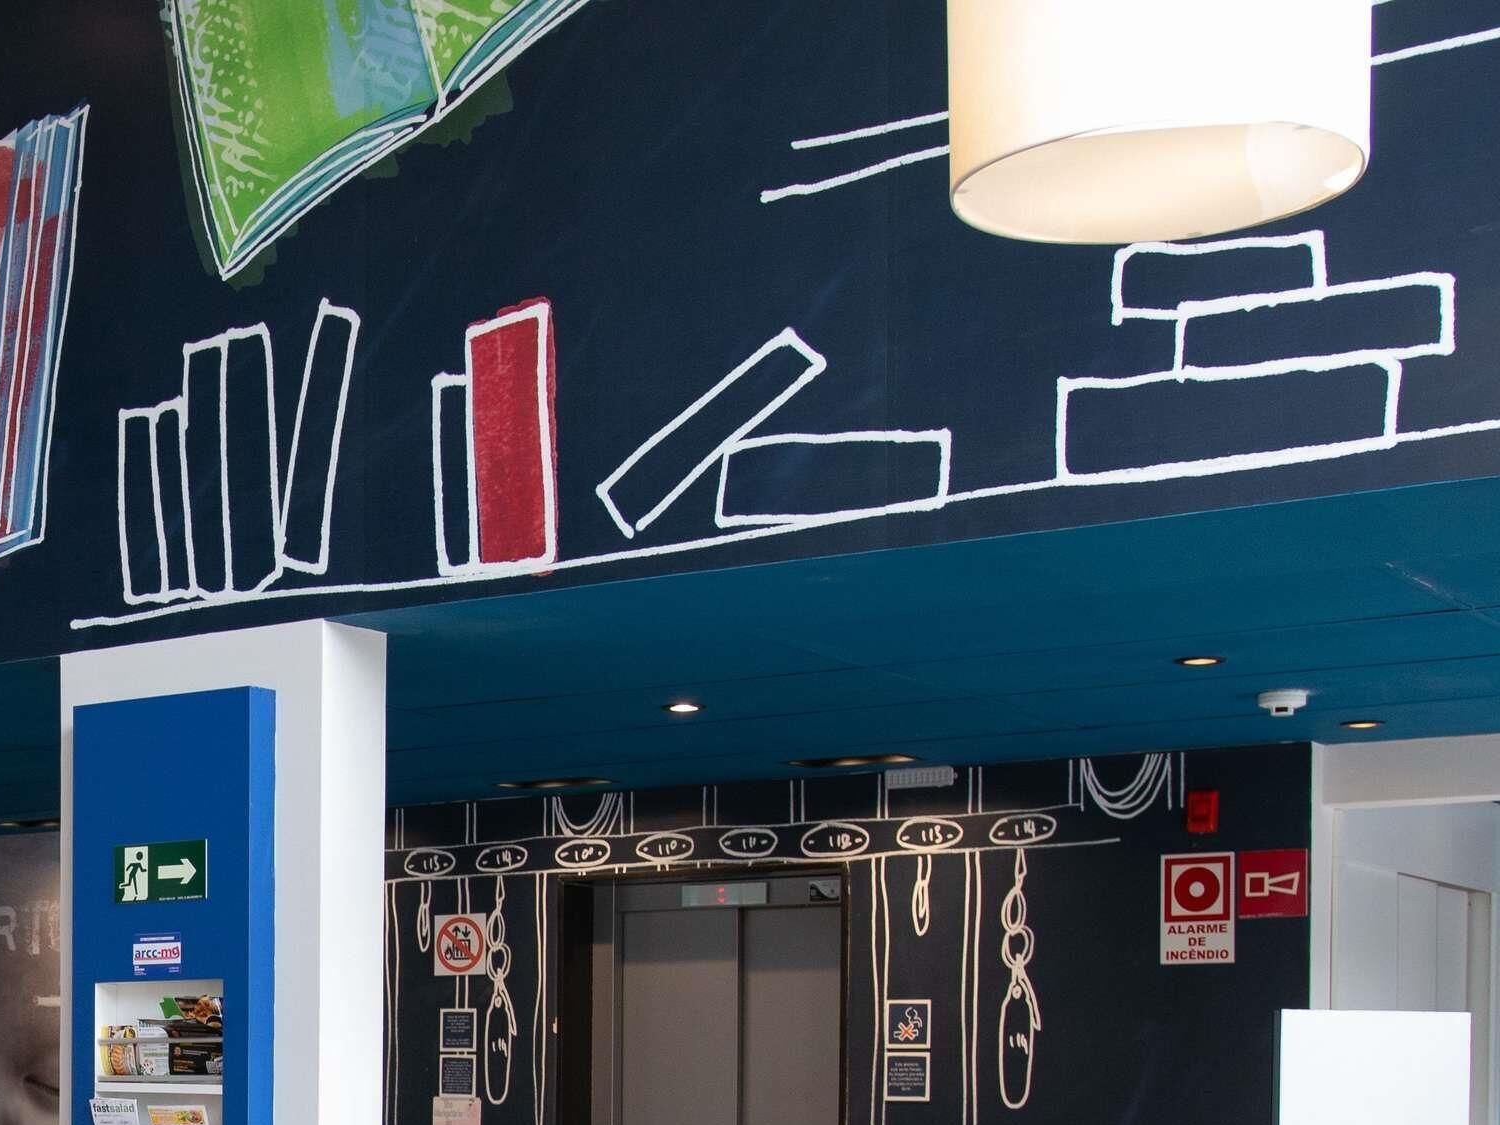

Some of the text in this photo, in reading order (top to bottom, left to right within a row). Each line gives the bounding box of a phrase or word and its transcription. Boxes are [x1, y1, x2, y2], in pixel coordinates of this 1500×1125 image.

[920, 824, 943, 843] 113
[1167, 923, 1228, 936] ALARME
[1187, 936, 1206, 947] DE
[1165, 948, 1229, 961] INCÊNDIO
